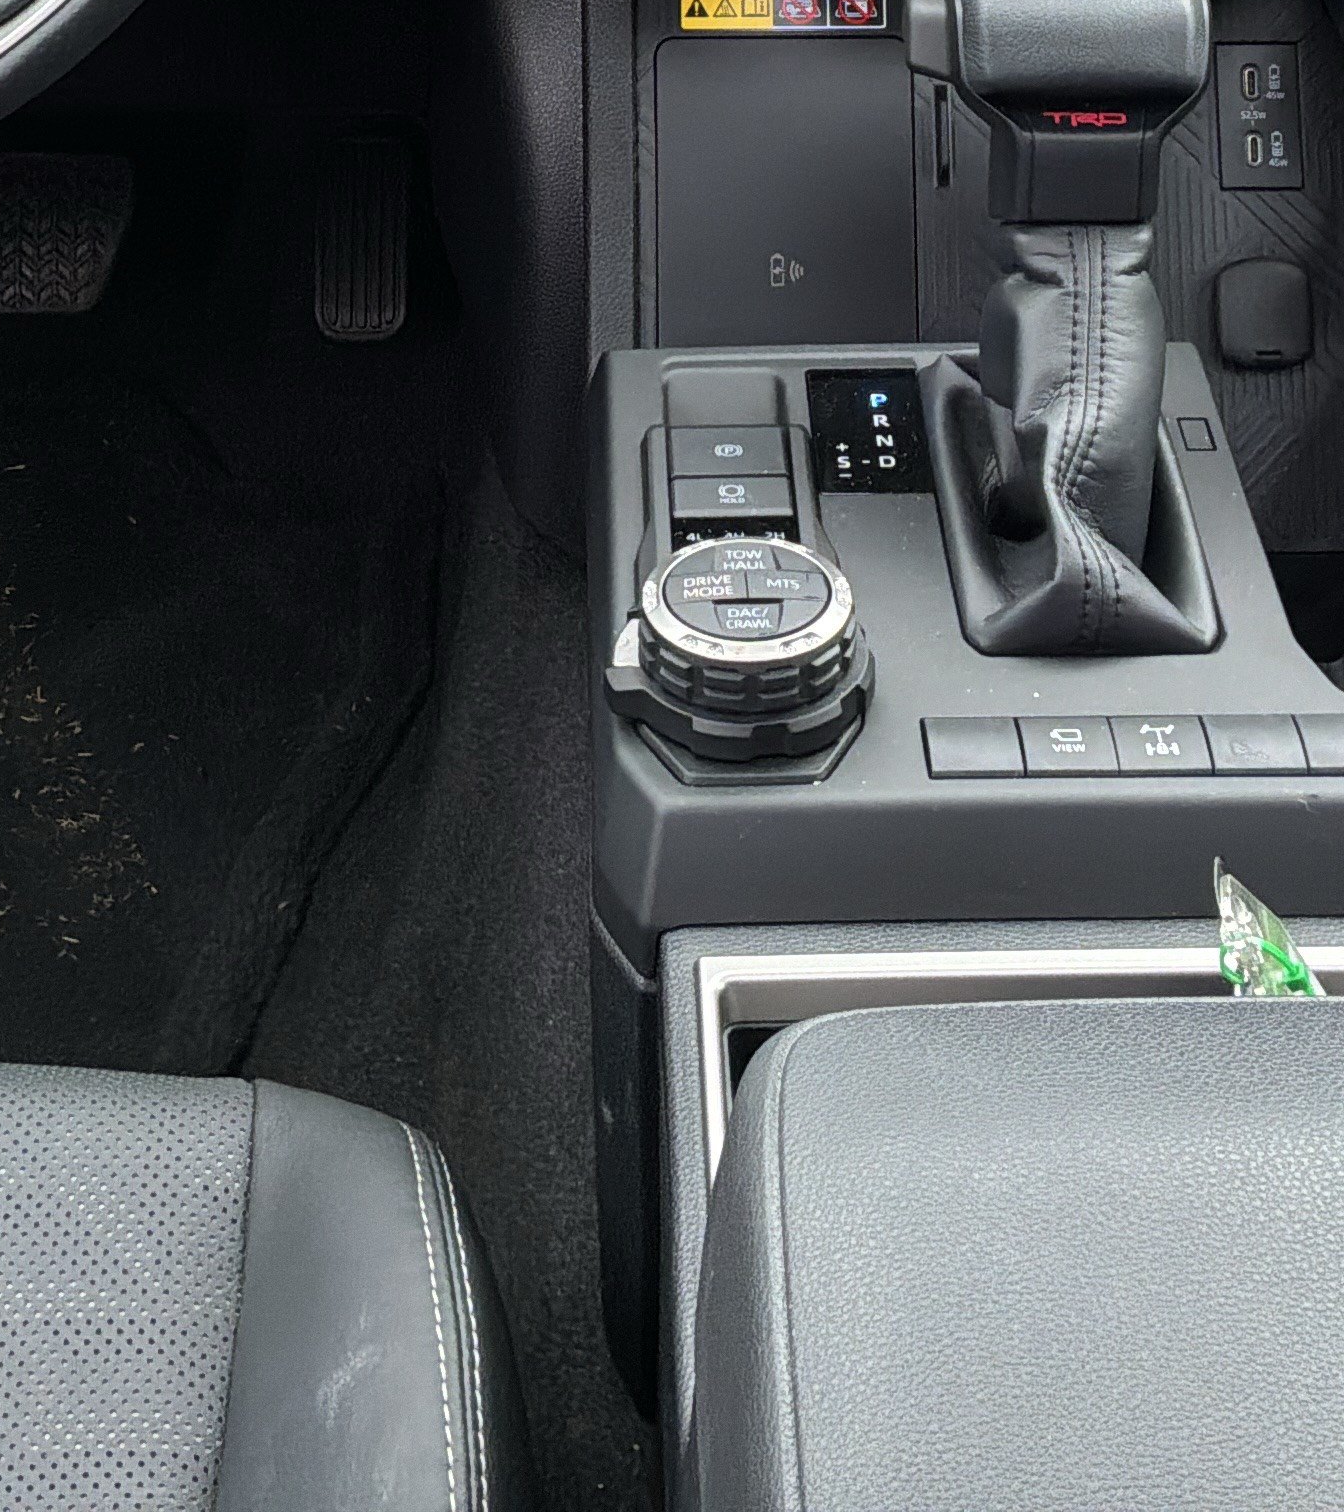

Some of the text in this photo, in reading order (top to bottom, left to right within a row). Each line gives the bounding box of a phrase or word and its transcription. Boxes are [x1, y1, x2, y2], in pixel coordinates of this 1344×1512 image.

[1043, 111, 1126, 127] TRD
[870, 393, 887, 408] P
[873, 415, 890, 428] R
[876, 435, 894, 447] N
[837, 456, 896, 468] S D
[719, 496, 745, 504] HOLD
[724, 549, 762, 560] TOW
[723, 558, 765, 570] HAUL
[683, 574, 732, 587] DRIVE
[766, 578, 800, 590] MTS
[684, 585, 734, 598] MODE
[727, 607, 768, 619] DAC/
[726, 618, 773, 630] CRAWL
[1052, 743, 1085, 753] VIEW
